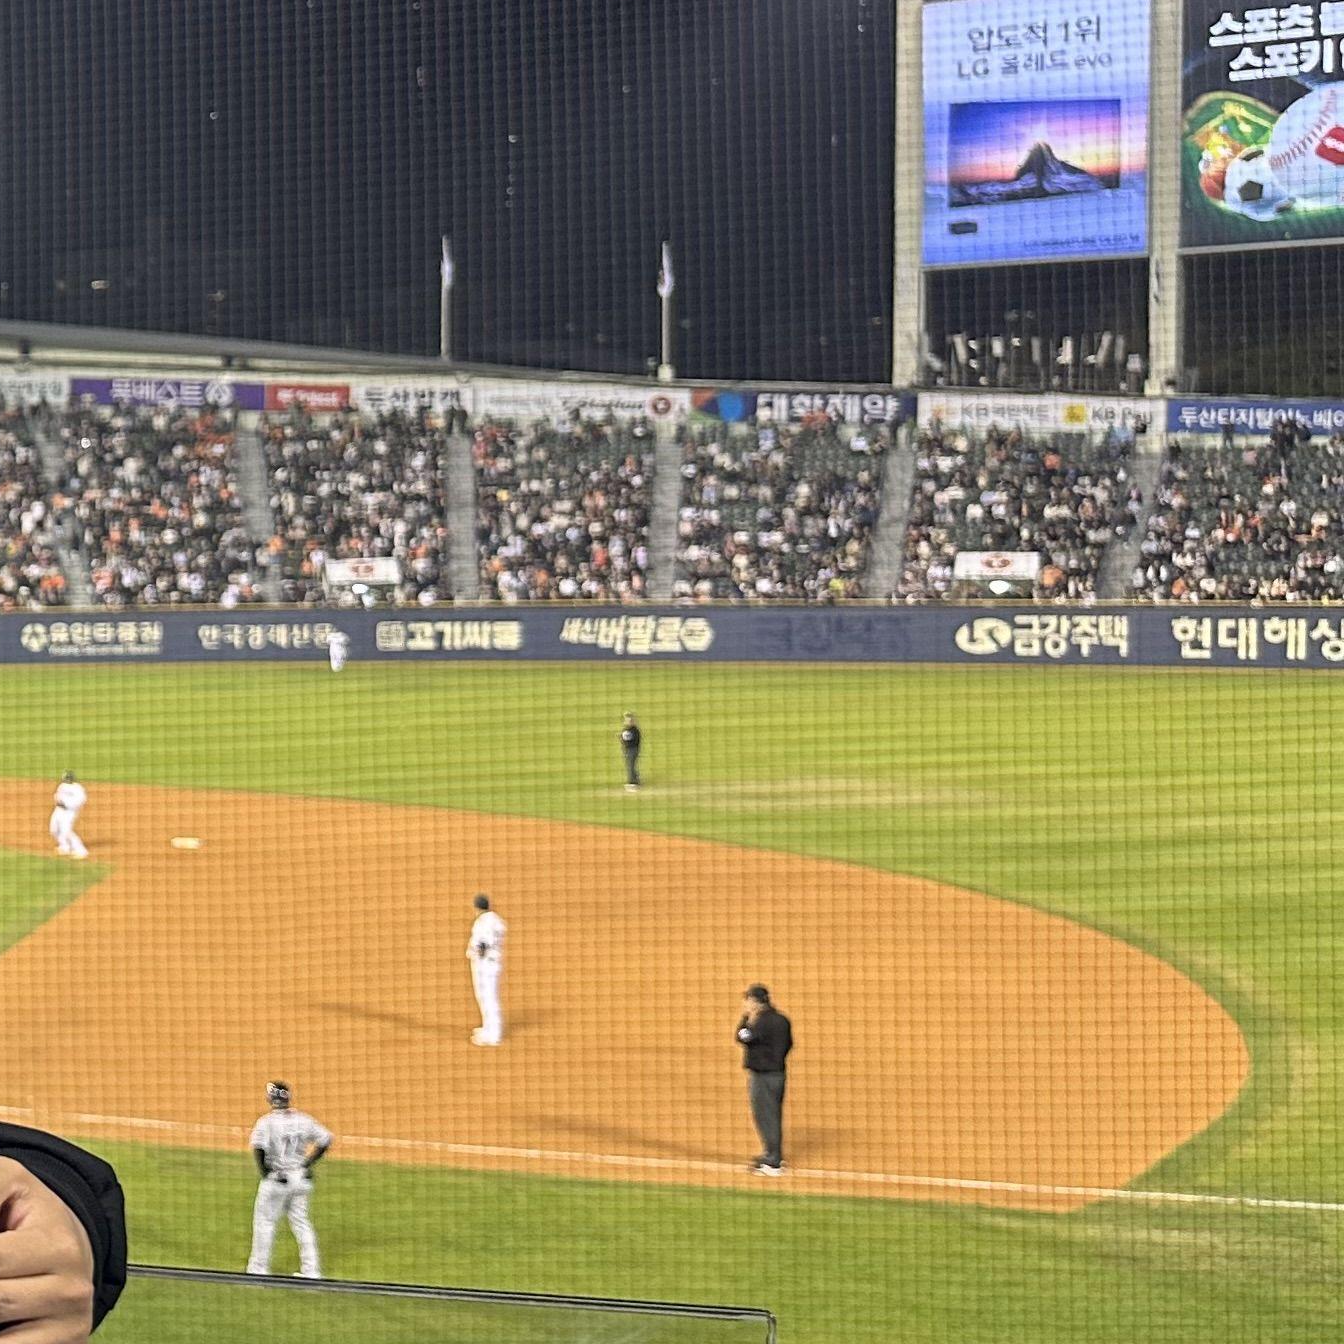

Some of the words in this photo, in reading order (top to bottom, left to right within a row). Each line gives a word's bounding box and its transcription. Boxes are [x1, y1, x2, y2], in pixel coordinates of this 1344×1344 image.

[1209, 4, 1314, 47] 스포츠
[958, 57, 989, 80] LG
[1229, 39, 1333, 82] 스포키
[1014, 614, 1128, 659] 금강주택
[1171, 616, 1344, 662] 현대해상
